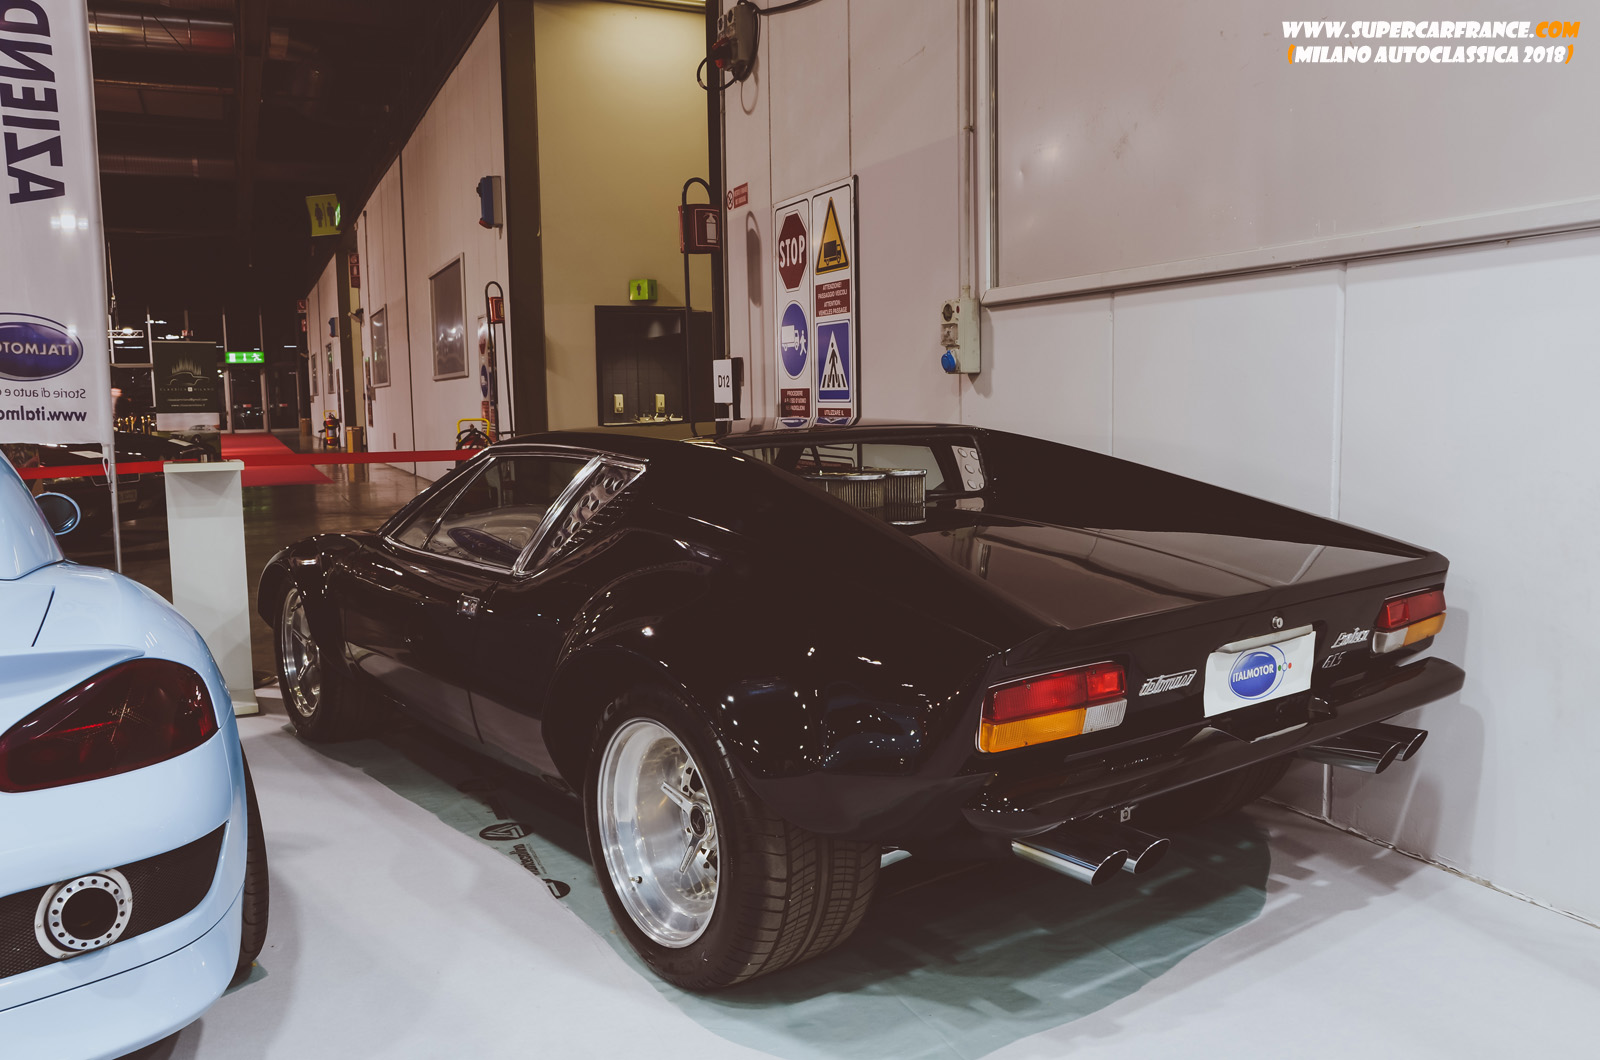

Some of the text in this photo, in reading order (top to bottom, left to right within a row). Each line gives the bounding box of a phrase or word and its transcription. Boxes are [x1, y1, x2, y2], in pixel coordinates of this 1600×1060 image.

[779, 234, 806, 269] STOP
[833, 306, 848, 315] PASSAGE
[717, 374, 730, 389] D12
[1232, 663, 1275, 683] ITALMOTOR
